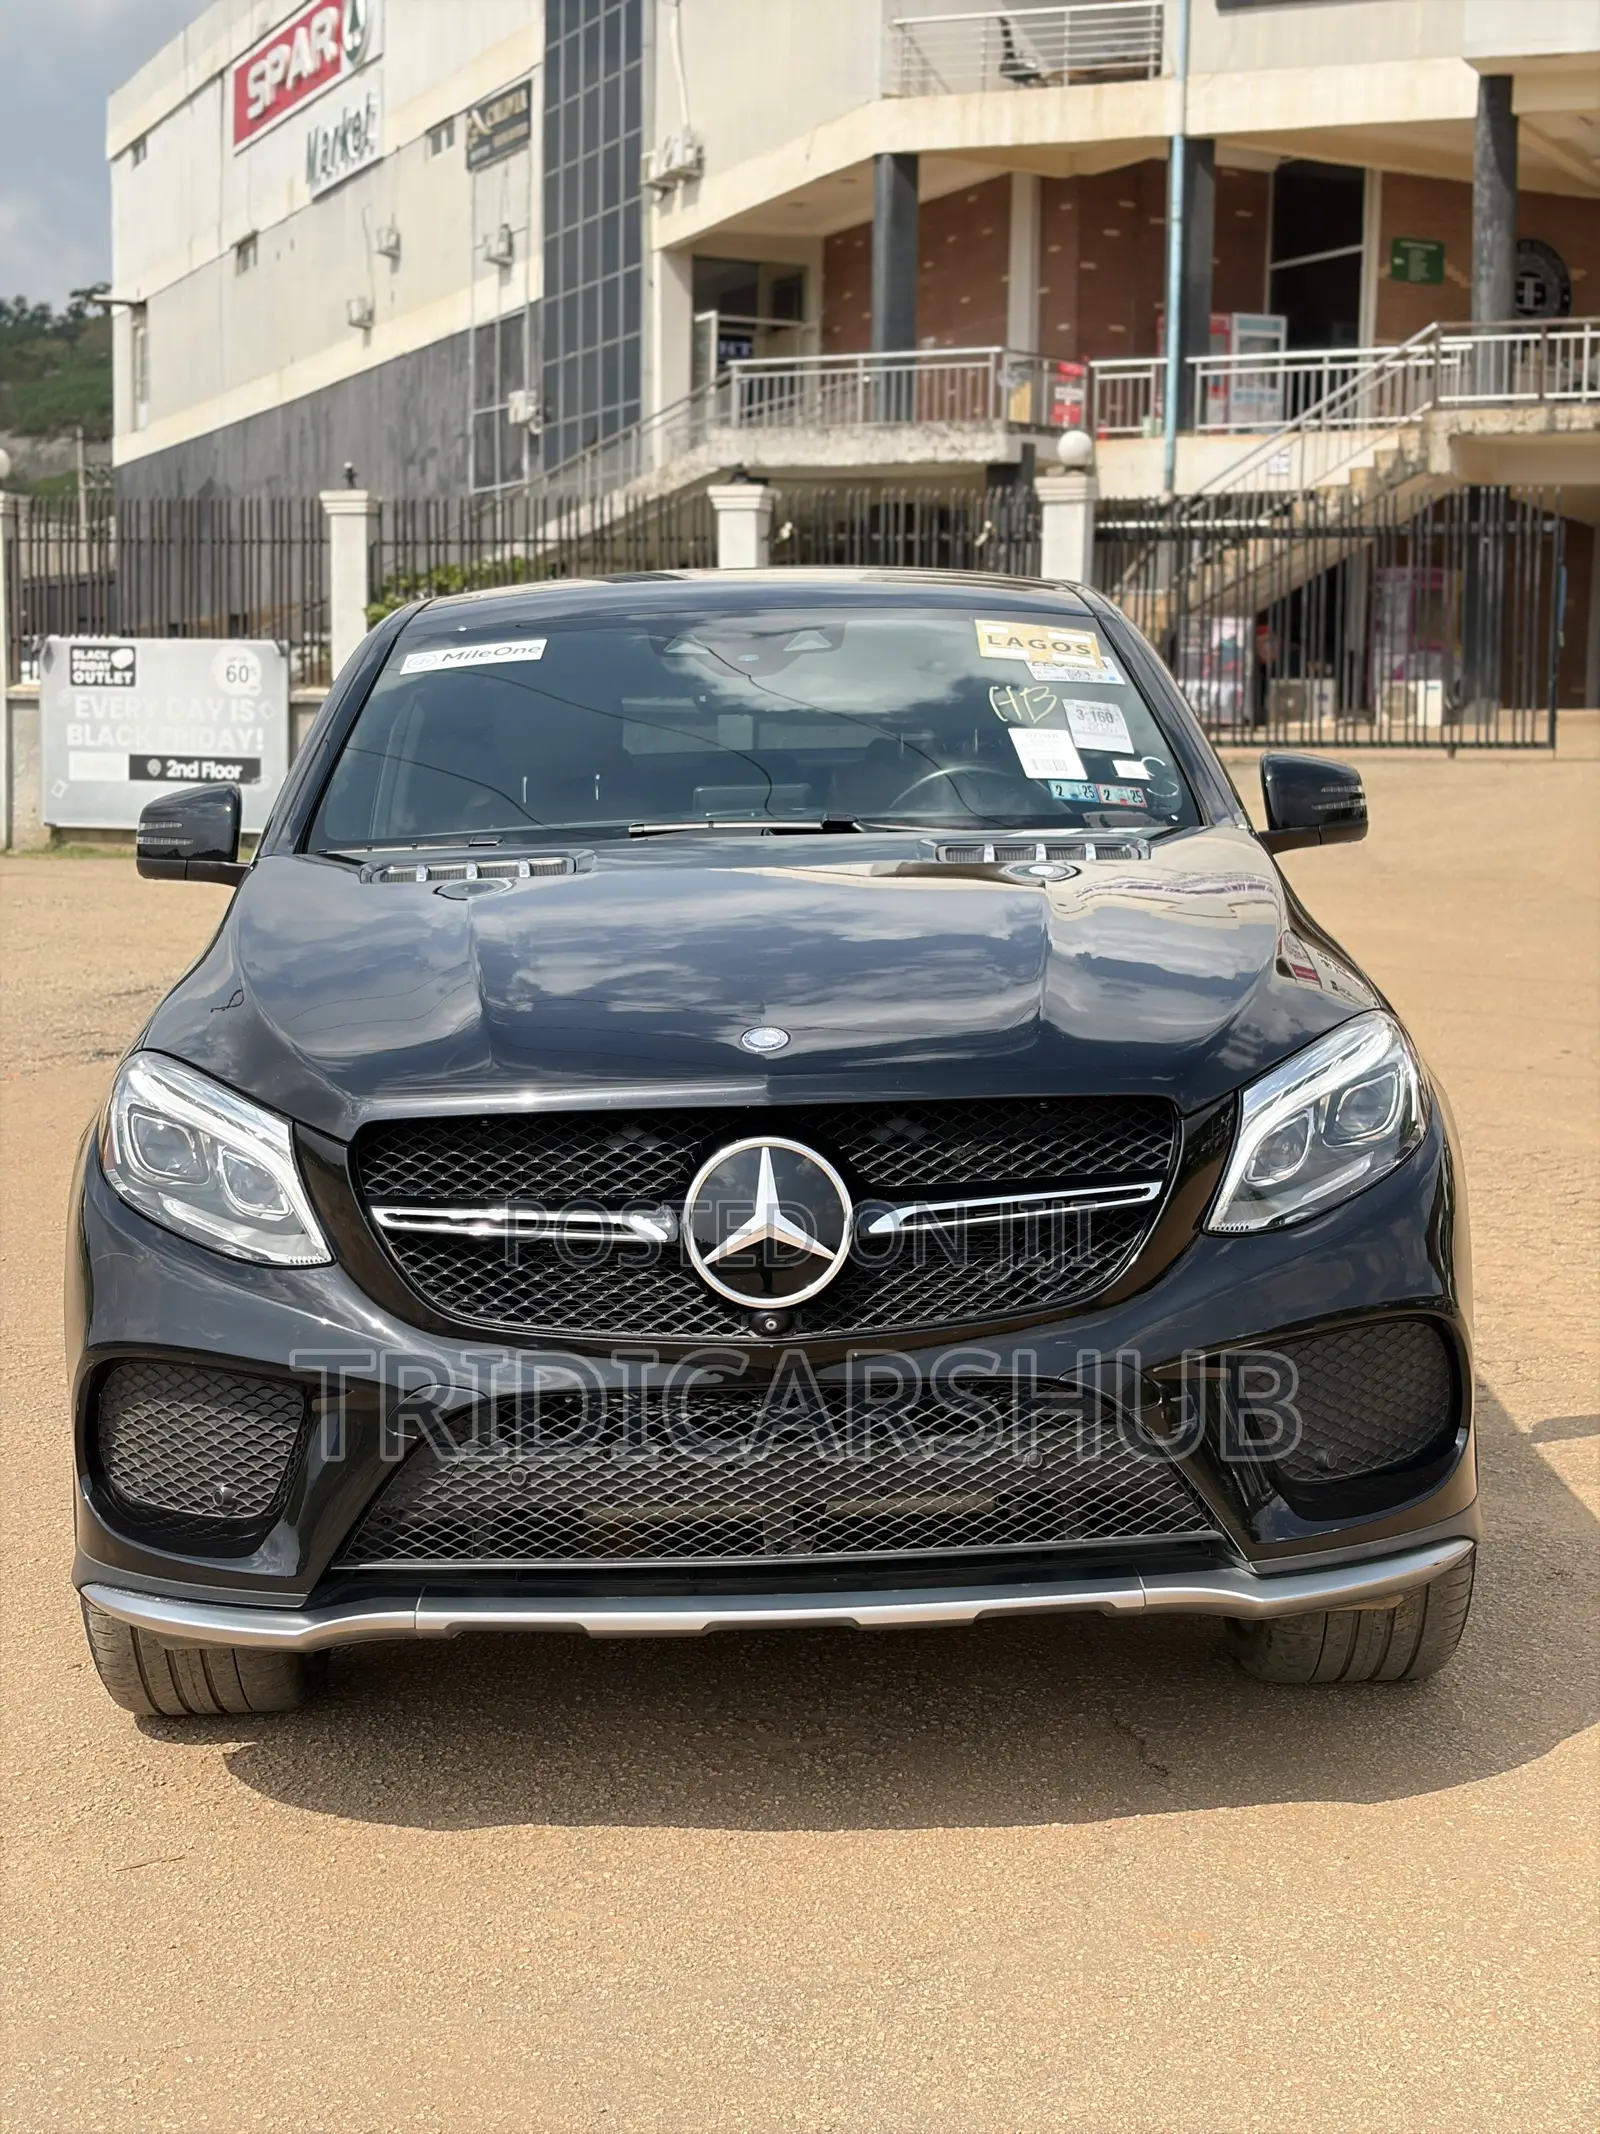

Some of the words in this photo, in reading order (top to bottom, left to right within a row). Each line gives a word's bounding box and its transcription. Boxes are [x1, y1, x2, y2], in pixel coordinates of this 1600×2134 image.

[247, 6, 340, 119] SPAR
[987, 635, 1091, 655] LAGOS
[72, 650, 110, 660] BLACK
[441, 646, 541, 662] MileOne
[72, 661, 112, 671] FRIDAY
[72, 671, 133, 684] OUTLET
[75, 694, 159, 719] EVERY
[166, 697, 225, 722] DAY
[231, 698, 256, 723] IS
[67, 723, 154, 747] BLACK
[160, 726, 265, 751] FRIDAY!
[166, 760, 200, 779] 2nd
[202, 761, 243, 780] Floor
[1055, 785, 1064, 797] 2
[1082, 785, 1095, 799] 25
[1103, 789, 1112, 801] 2
[1130, 790, 1144, 803] 25
